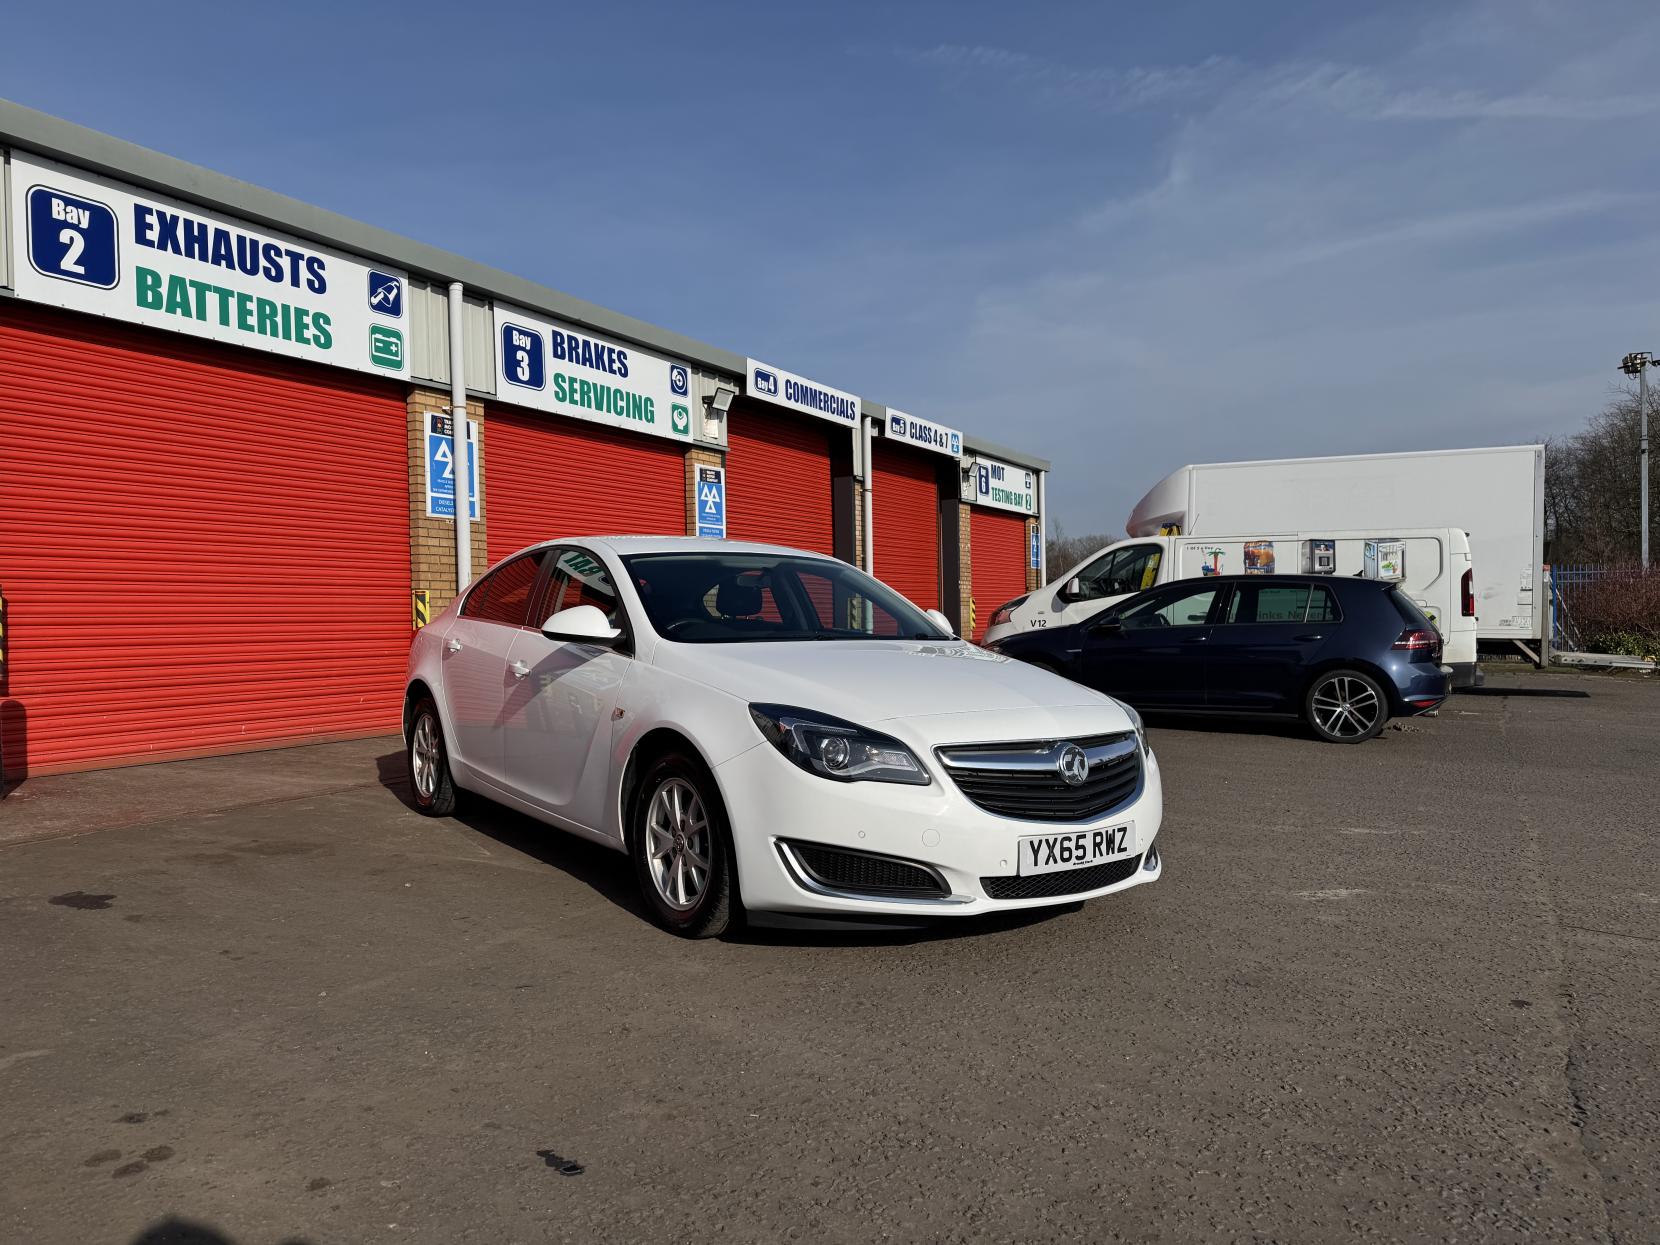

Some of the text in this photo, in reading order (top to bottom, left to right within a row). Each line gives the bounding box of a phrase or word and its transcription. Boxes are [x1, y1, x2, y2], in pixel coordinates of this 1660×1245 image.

[51, 198, 90, 229] Bay
[59, 228, 85, 275] 2
[133, 203, 327, 295] EXHAUSTS
[135, 265, 333, 350] BATTERIES
[512, 330, 531, 350] Bay
[552, 329, 629, 378] BRAKES
[516, 350, 530, 382] 3
[553, 372, 655, 424] SERVICING
[757, 375, 856, 421] Bay 4 COMMERCIALS
[909, 421, 932, 445] CLASS
[933, 428, 938, 446] 4
[939, 433, 944, 448] &
[944, 432, 949, 449] 7
[991, 464, 1005, 482] MOT
[991, 487, 1024, 507] TESTING BAY
[1030, 826, 1128, 867] YX65 RWZ
